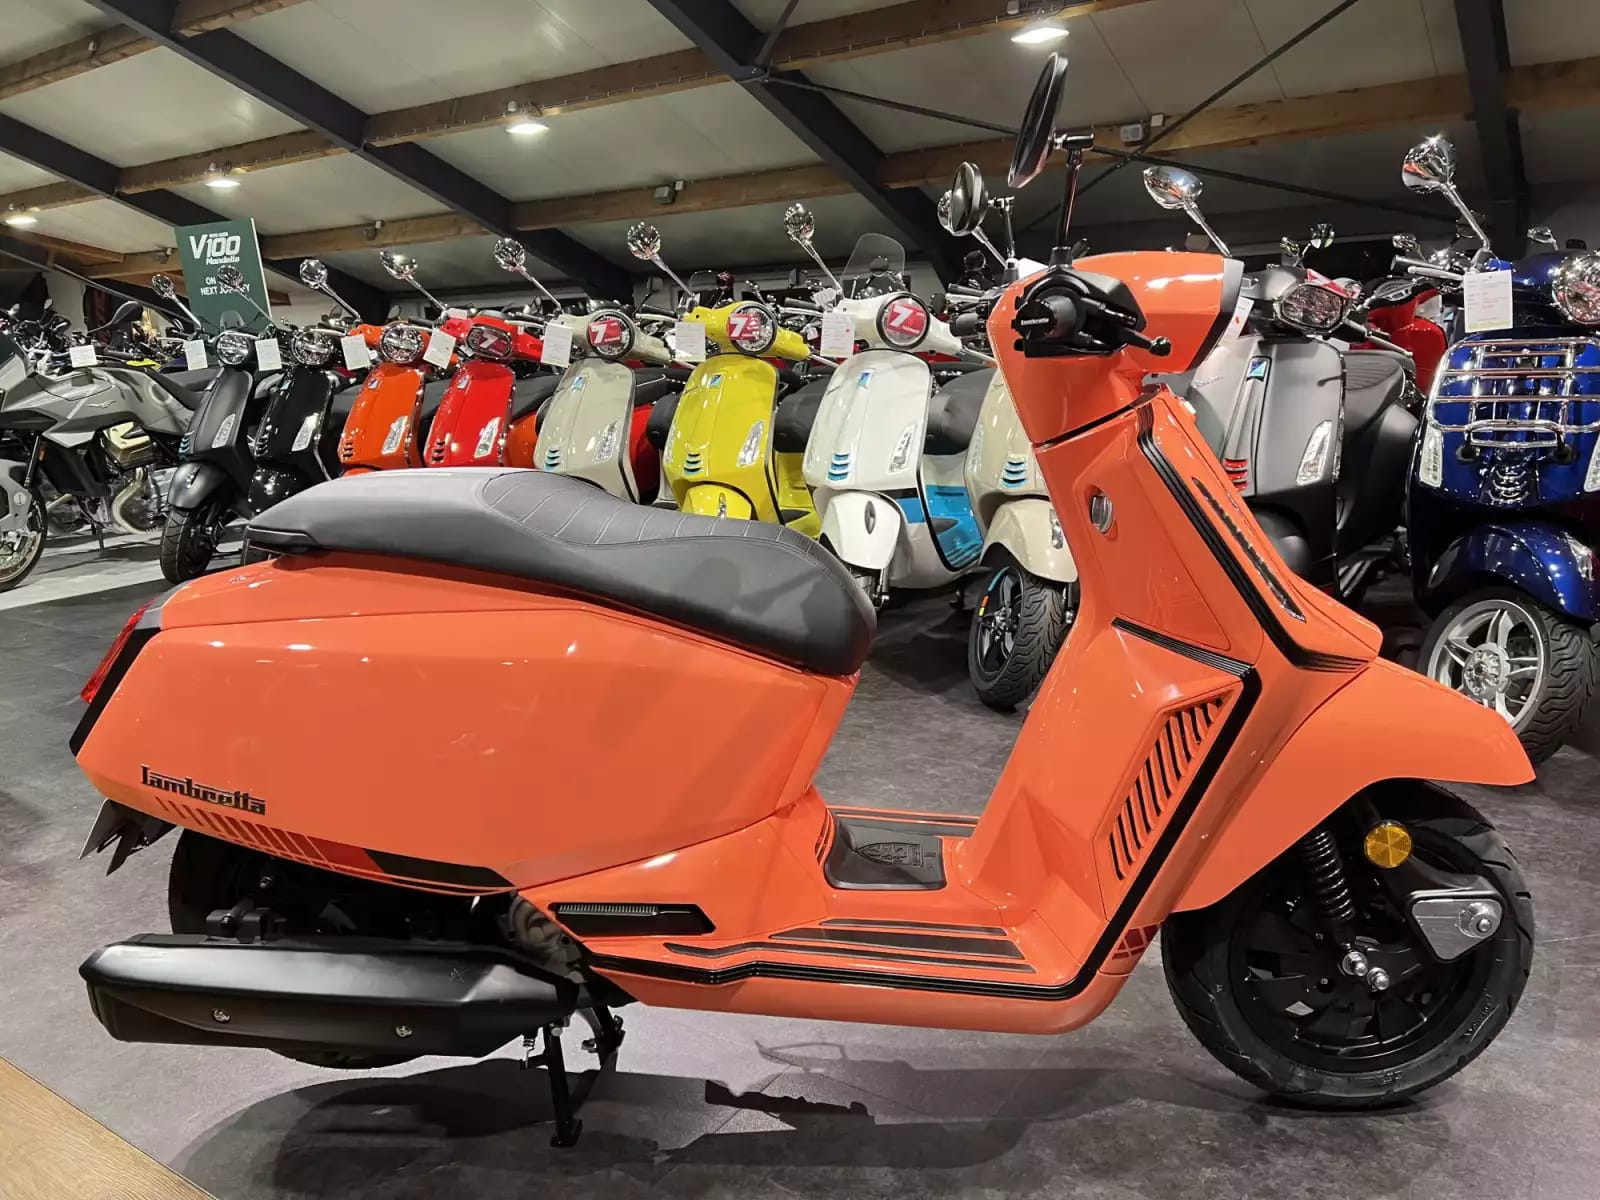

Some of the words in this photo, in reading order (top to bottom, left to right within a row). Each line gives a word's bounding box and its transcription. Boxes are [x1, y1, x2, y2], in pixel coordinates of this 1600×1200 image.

[189, 234, 241, 259] V100
[200, 286, 218, 296] NEXT
[205, 276, 217, 285] ON
[889, 304, 914, 327] 7
[590, 323, 608, 344] 7
[729, 316, 749, 338] 7
